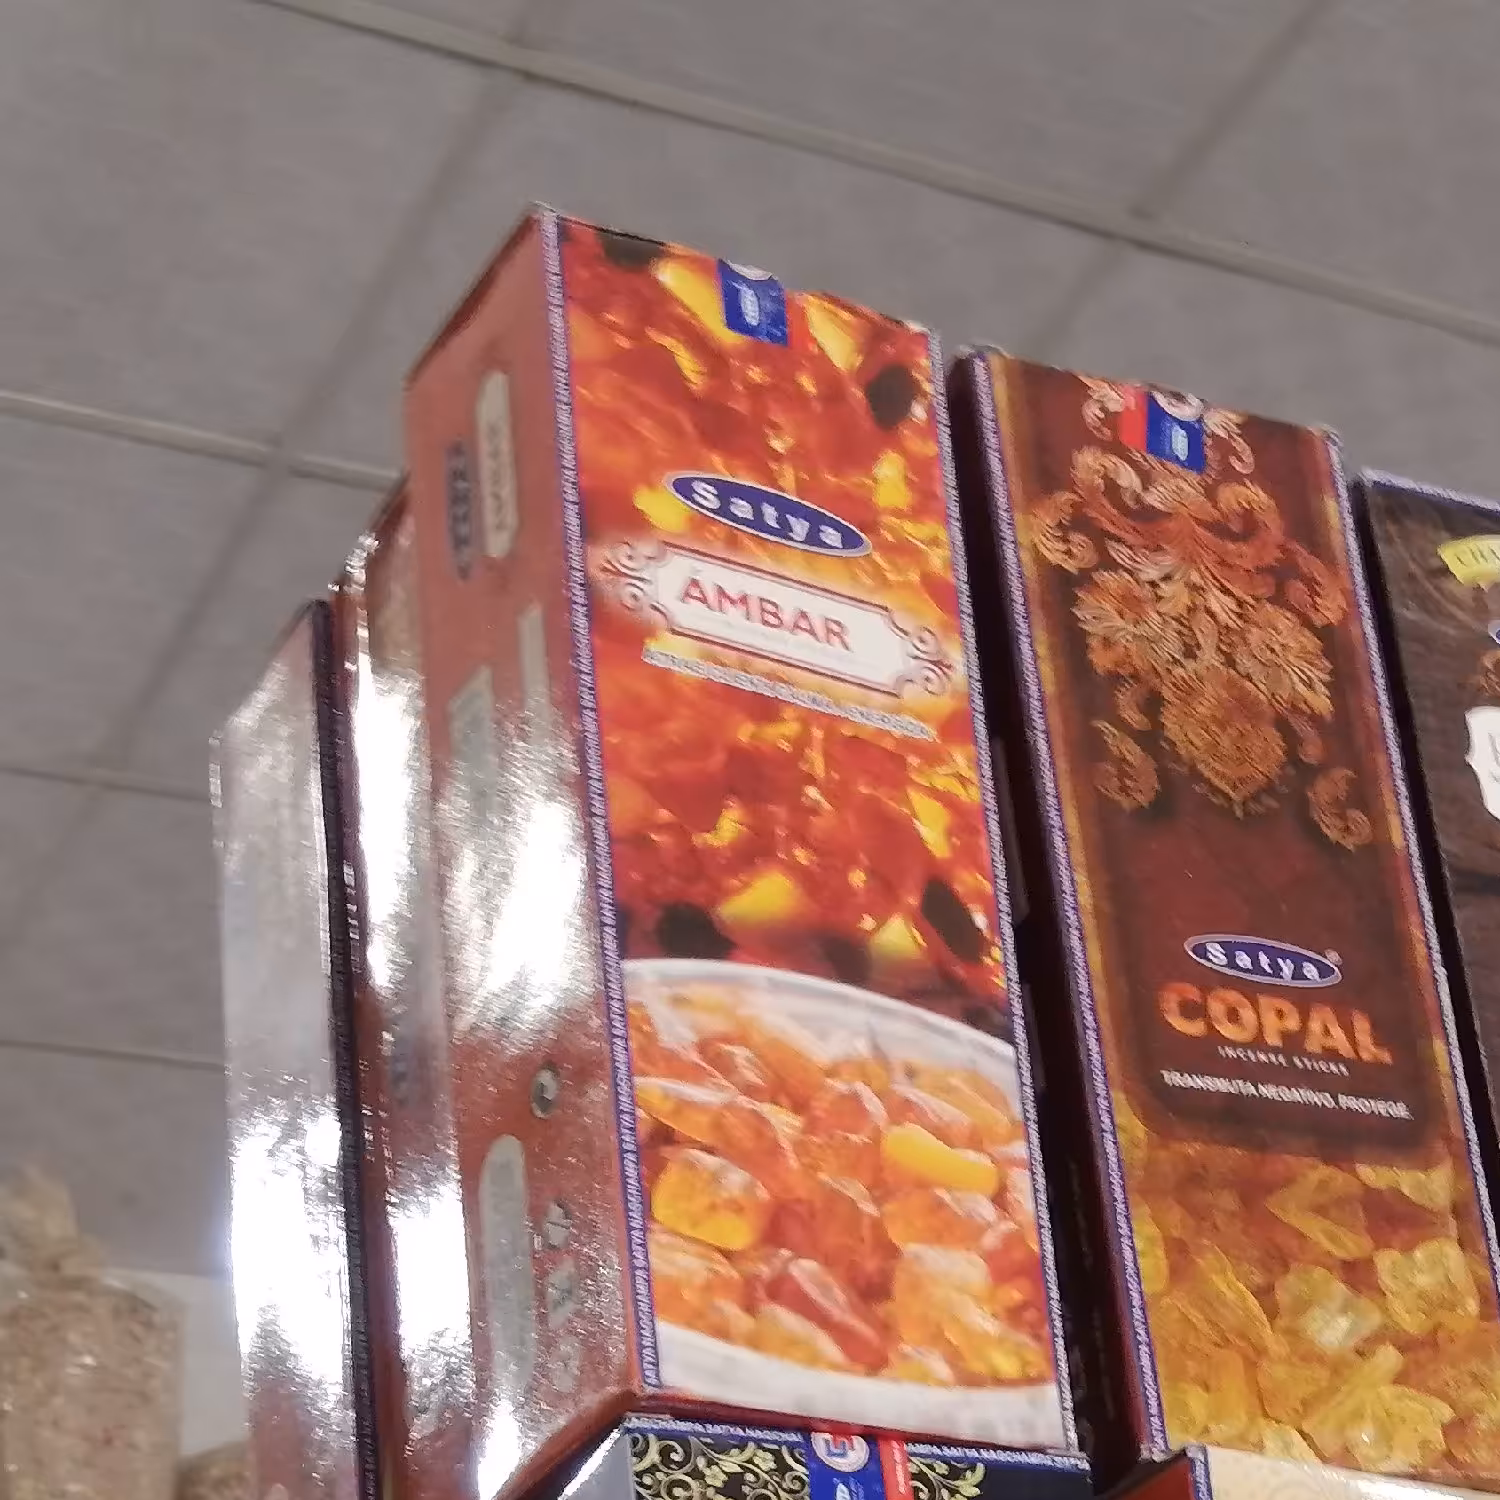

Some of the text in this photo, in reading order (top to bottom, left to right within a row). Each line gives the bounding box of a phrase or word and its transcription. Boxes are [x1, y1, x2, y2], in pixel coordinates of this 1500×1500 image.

[691, 480, 844, 550] Satya
[680, 575, 853, 652] AMBAR
[1205, 941, 1321, 984] Satya
[1159, 981, 1394, 1067] COPAL
